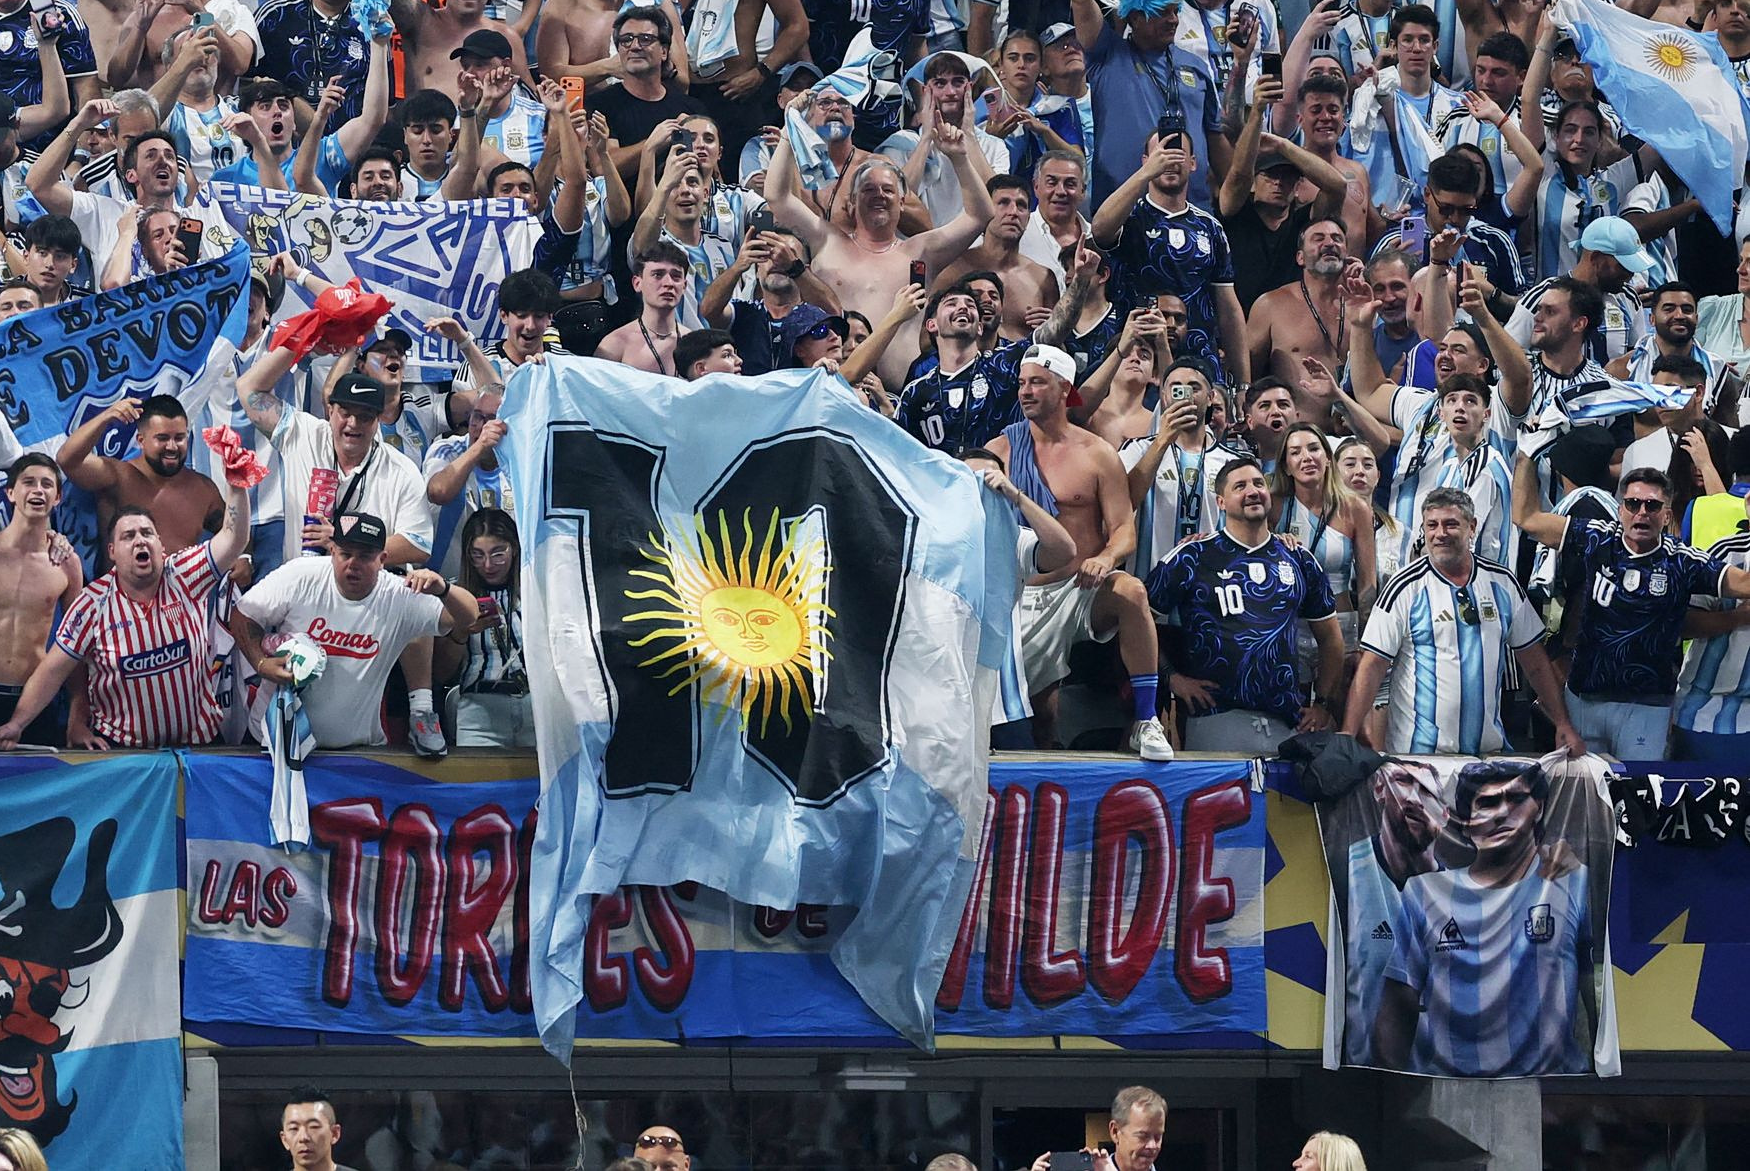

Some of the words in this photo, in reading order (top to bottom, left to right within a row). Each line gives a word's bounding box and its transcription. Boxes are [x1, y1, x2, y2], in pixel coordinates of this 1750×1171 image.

[43, 282, 239, 402] DEVOT
[919, 414, 945, 447] 10
[1214, 583, 1246, 617] 10
[1592, 571, 1617, 608] 10
[306, 616, 374, 649] Lomas
[544, 421, 919, 809] 10
[121, 644, 187, 673] CartaSur
[198, 858, 299, 929] LAS
[311, 796, 697, 1013] TORES
